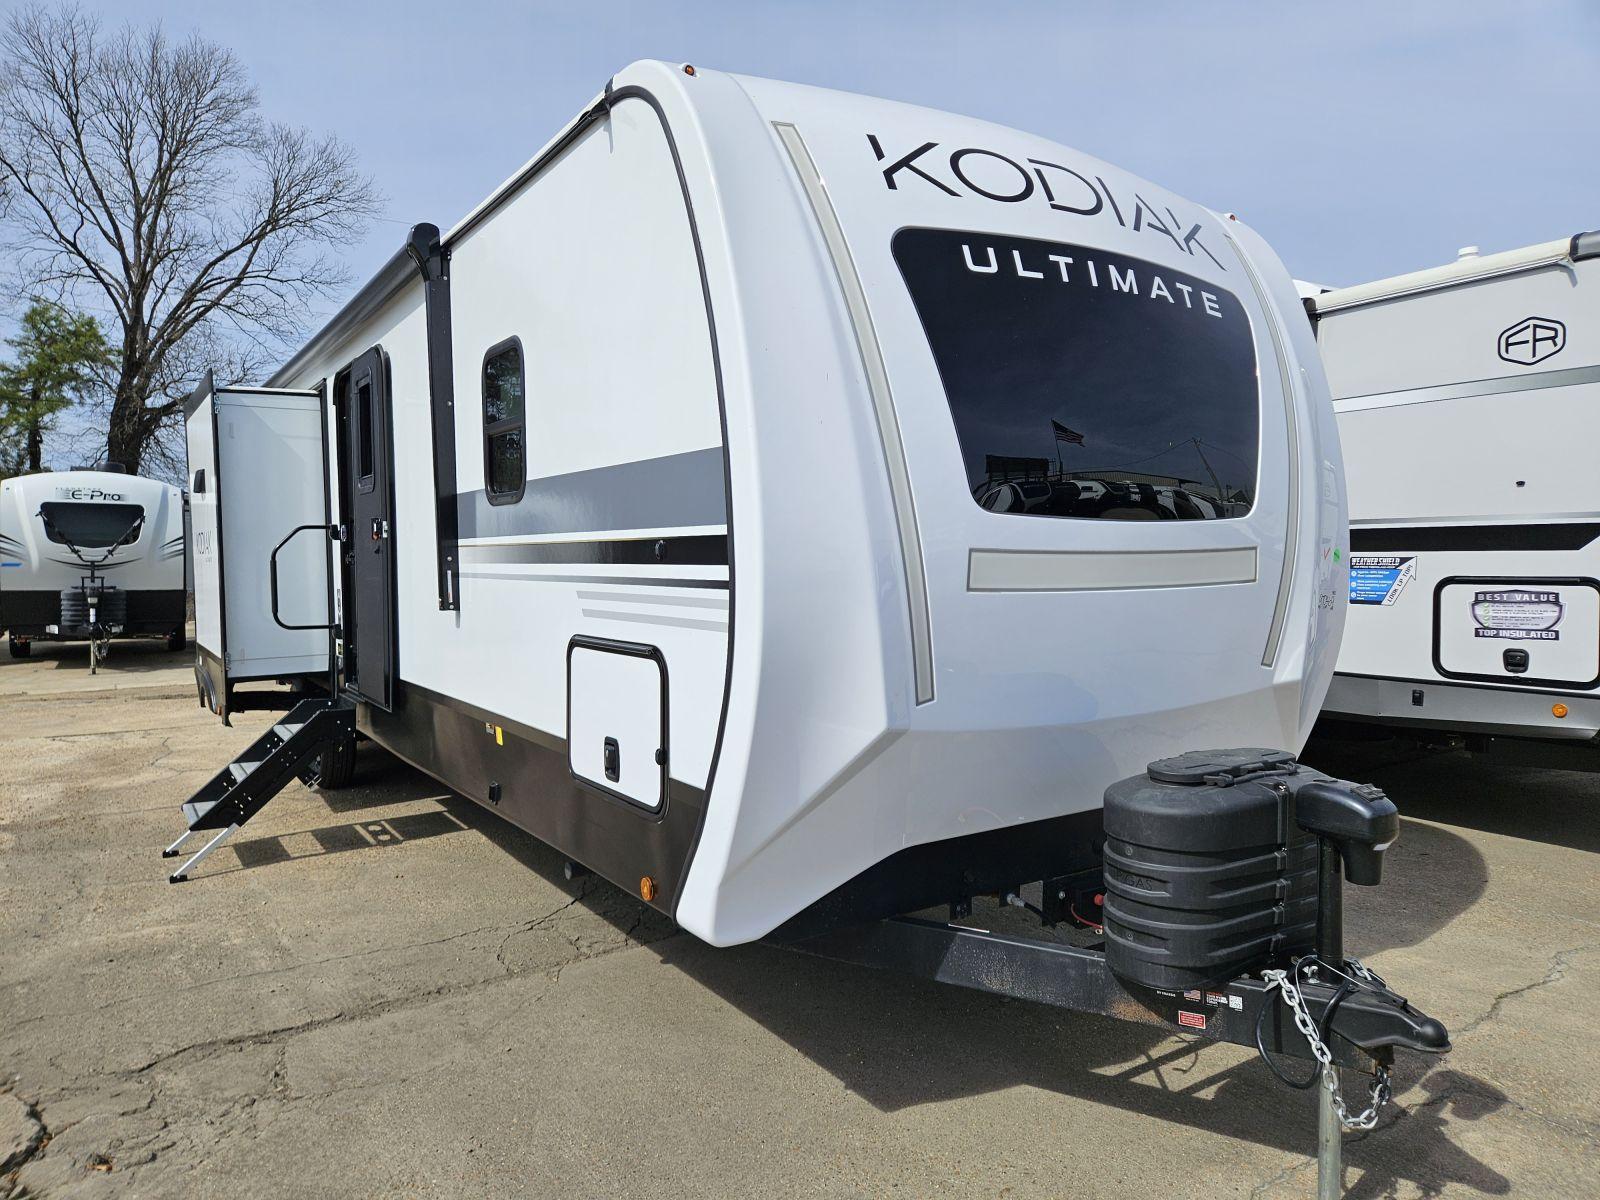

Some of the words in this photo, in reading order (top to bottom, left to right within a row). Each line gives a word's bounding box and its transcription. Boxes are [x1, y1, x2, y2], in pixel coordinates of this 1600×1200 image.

[866, 133, 1227, 271] KODIAK
[961, 244, 1222, 318] ULTIMATE
[1504, 323, 1558, 358] FR
[71, 489, 120, 501] E-Pro
[1477, 593, 1508, 601] BEST
[1514, 593, 1556, 602] VALUE
[1477, 629, 1497, 637] TOP
[1499, 630, 1556, 639] INSULATED
